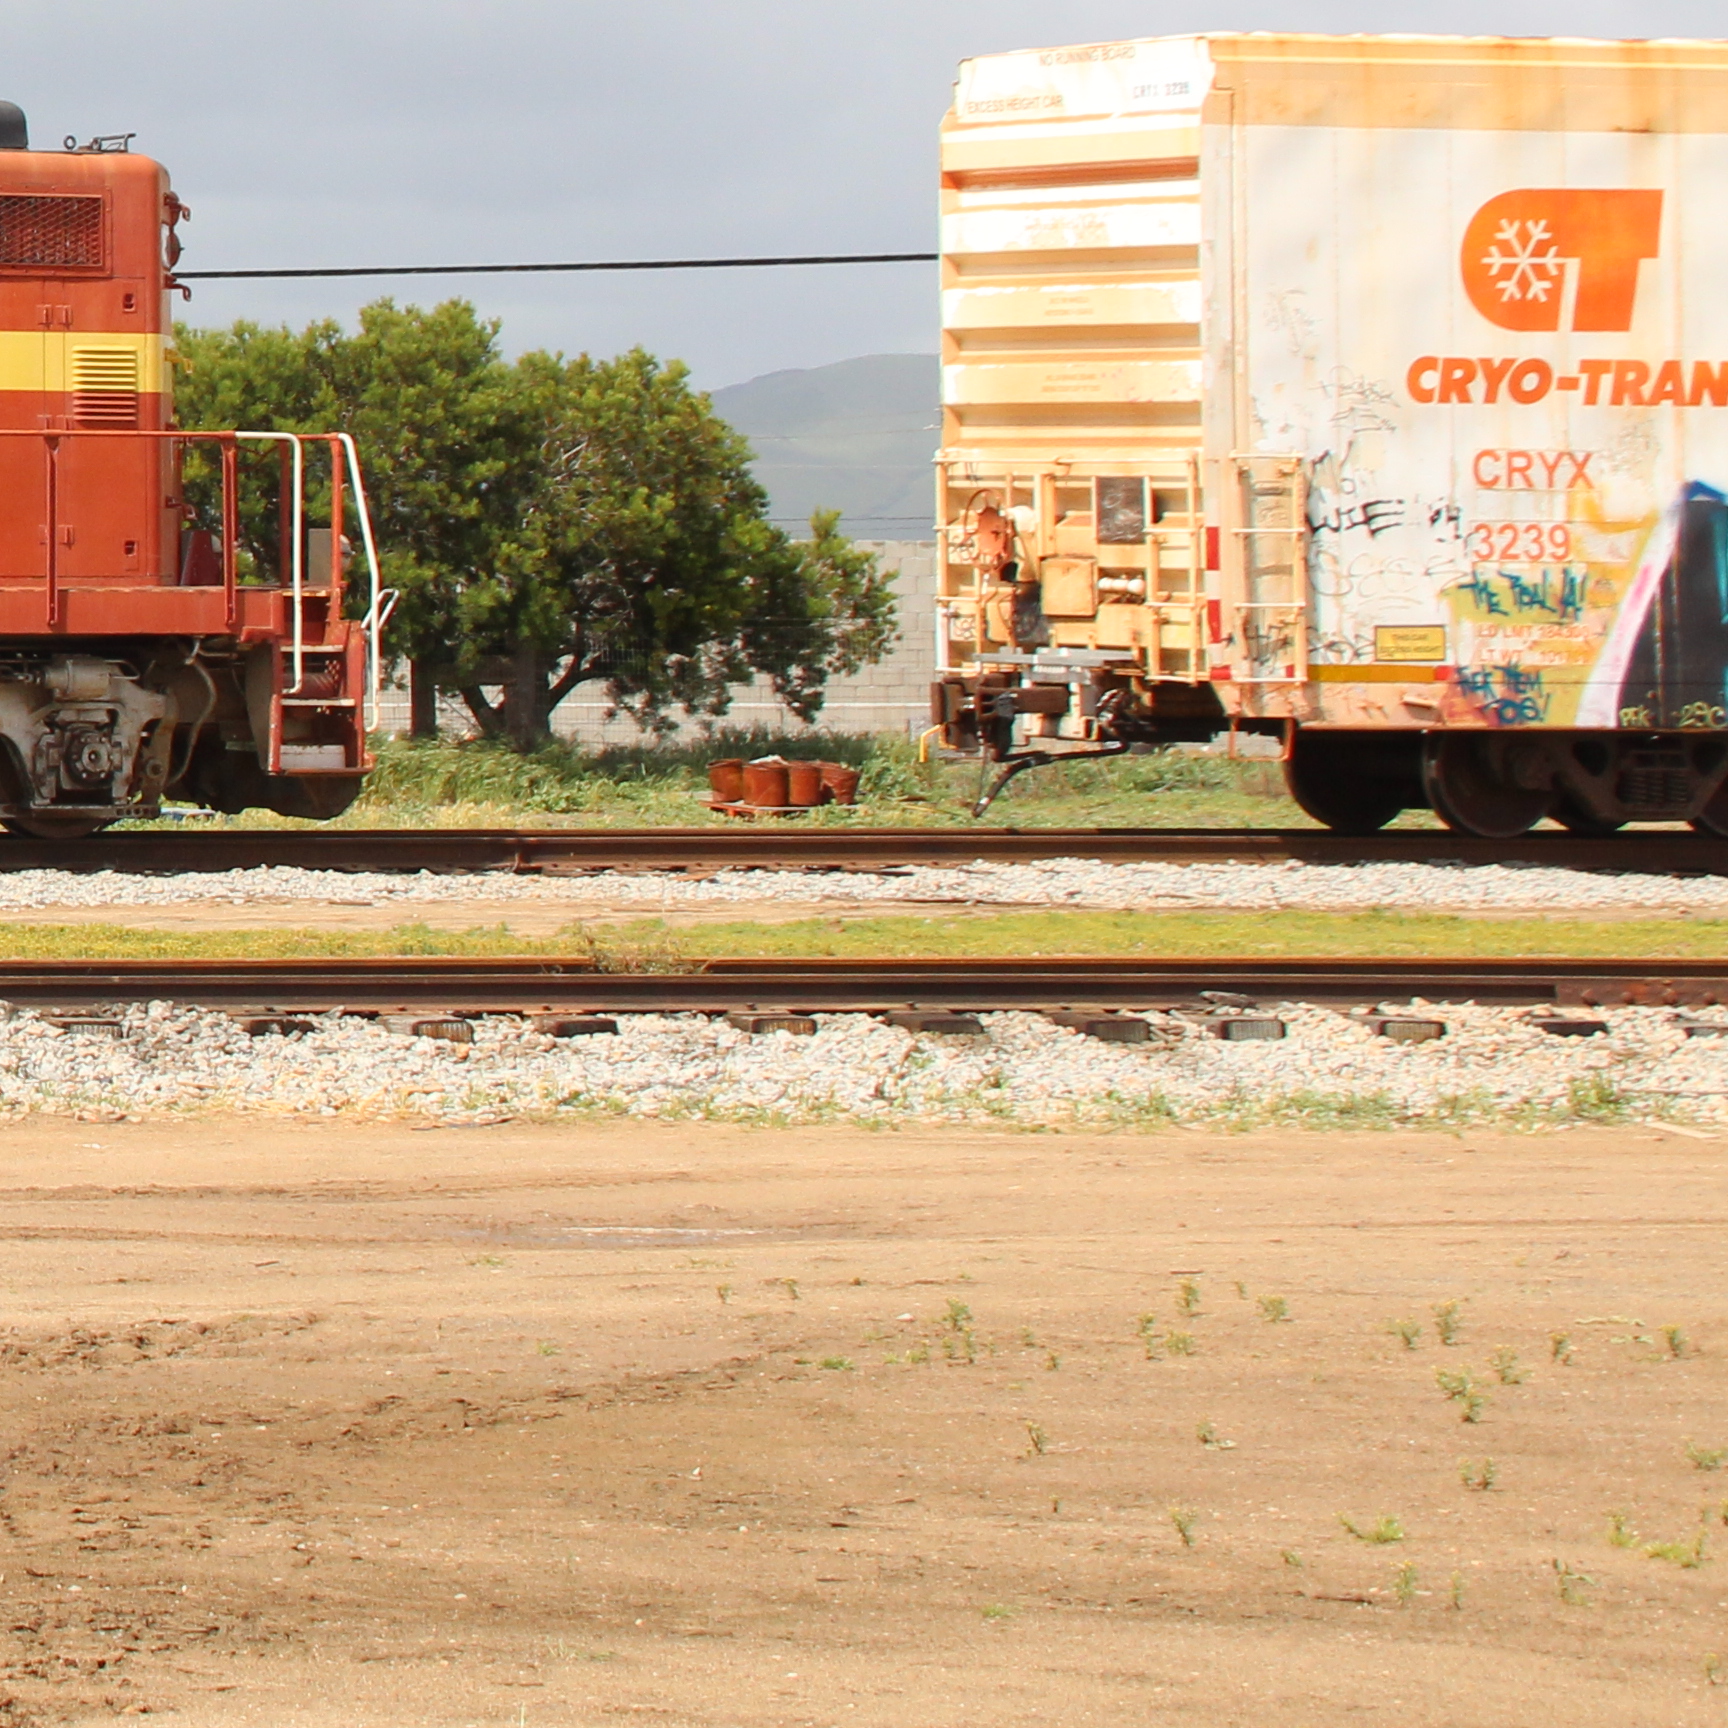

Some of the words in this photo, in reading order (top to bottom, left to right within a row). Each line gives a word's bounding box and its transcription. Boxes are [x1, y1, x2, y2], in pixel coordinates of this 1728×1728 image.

[967, 99, 1005, 114] EXCESS
[1007, 96, 1040, 112] HEIGHT
[1043, 94, 1064, 109] CAR
[1472, 448, 1594, 489] CRYX
[1472, 523, 1571, 561] 3239
